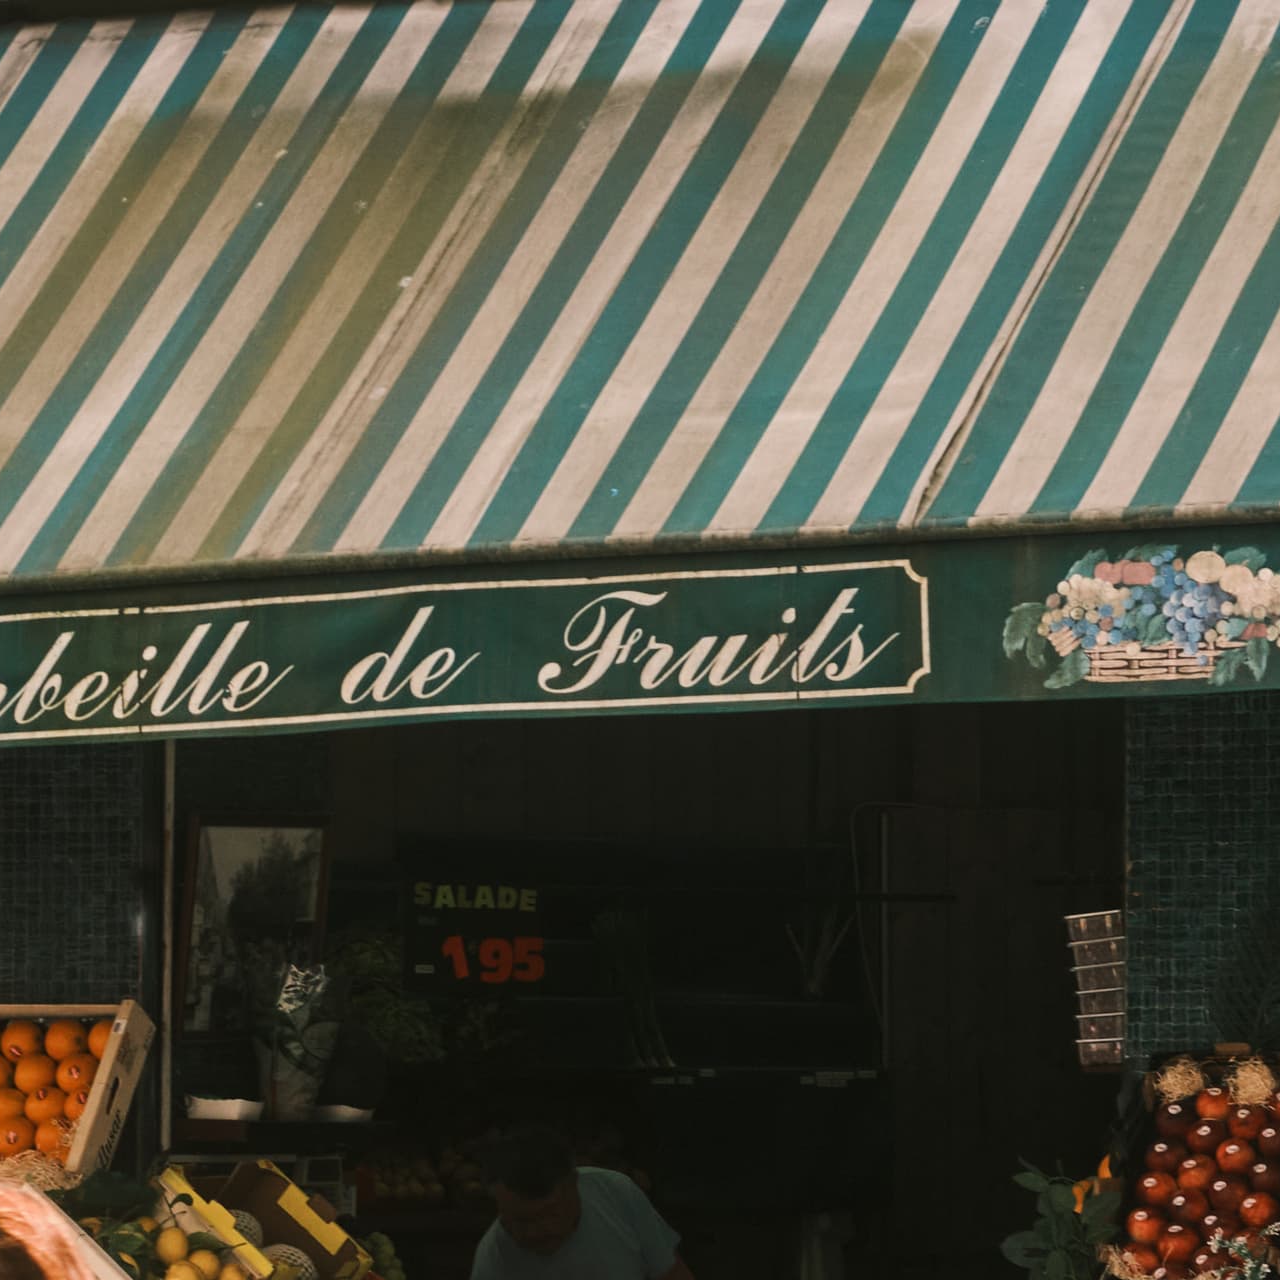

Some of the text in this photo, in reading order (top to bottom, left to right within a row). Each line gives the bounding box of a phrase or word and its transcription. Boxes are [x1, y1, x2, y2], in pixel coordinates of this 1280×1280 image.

[340, 604, 481, 705] de
[536, 587, 901, 695] Fruits
[414, 882, 538, 912] SALADE
